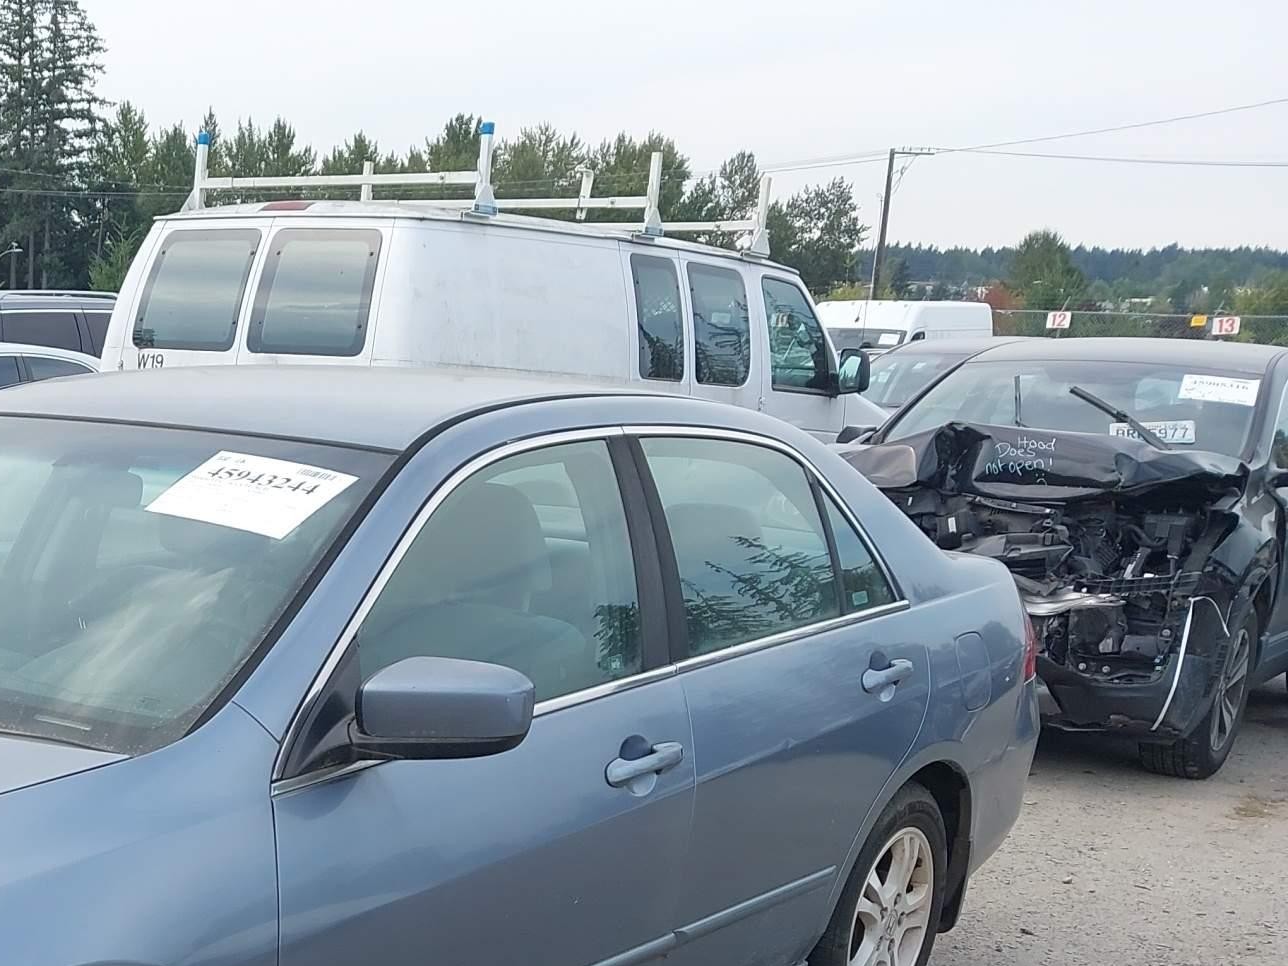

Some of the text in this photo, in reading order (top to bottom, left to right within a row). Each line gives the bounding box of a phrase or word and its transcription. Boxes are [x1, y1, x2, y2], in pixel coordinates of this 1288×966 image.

[1051, 313, 1066, 327] 12
[1218, 318, 1234, 333] 13
[137, 353, 164, 369] W19
[995, 442, 1036, 457] Does
[1018, 436, 1056, 451] Hood
[986, 459, 1006, 475] not
[208, 466, 321, 495] 45943244
